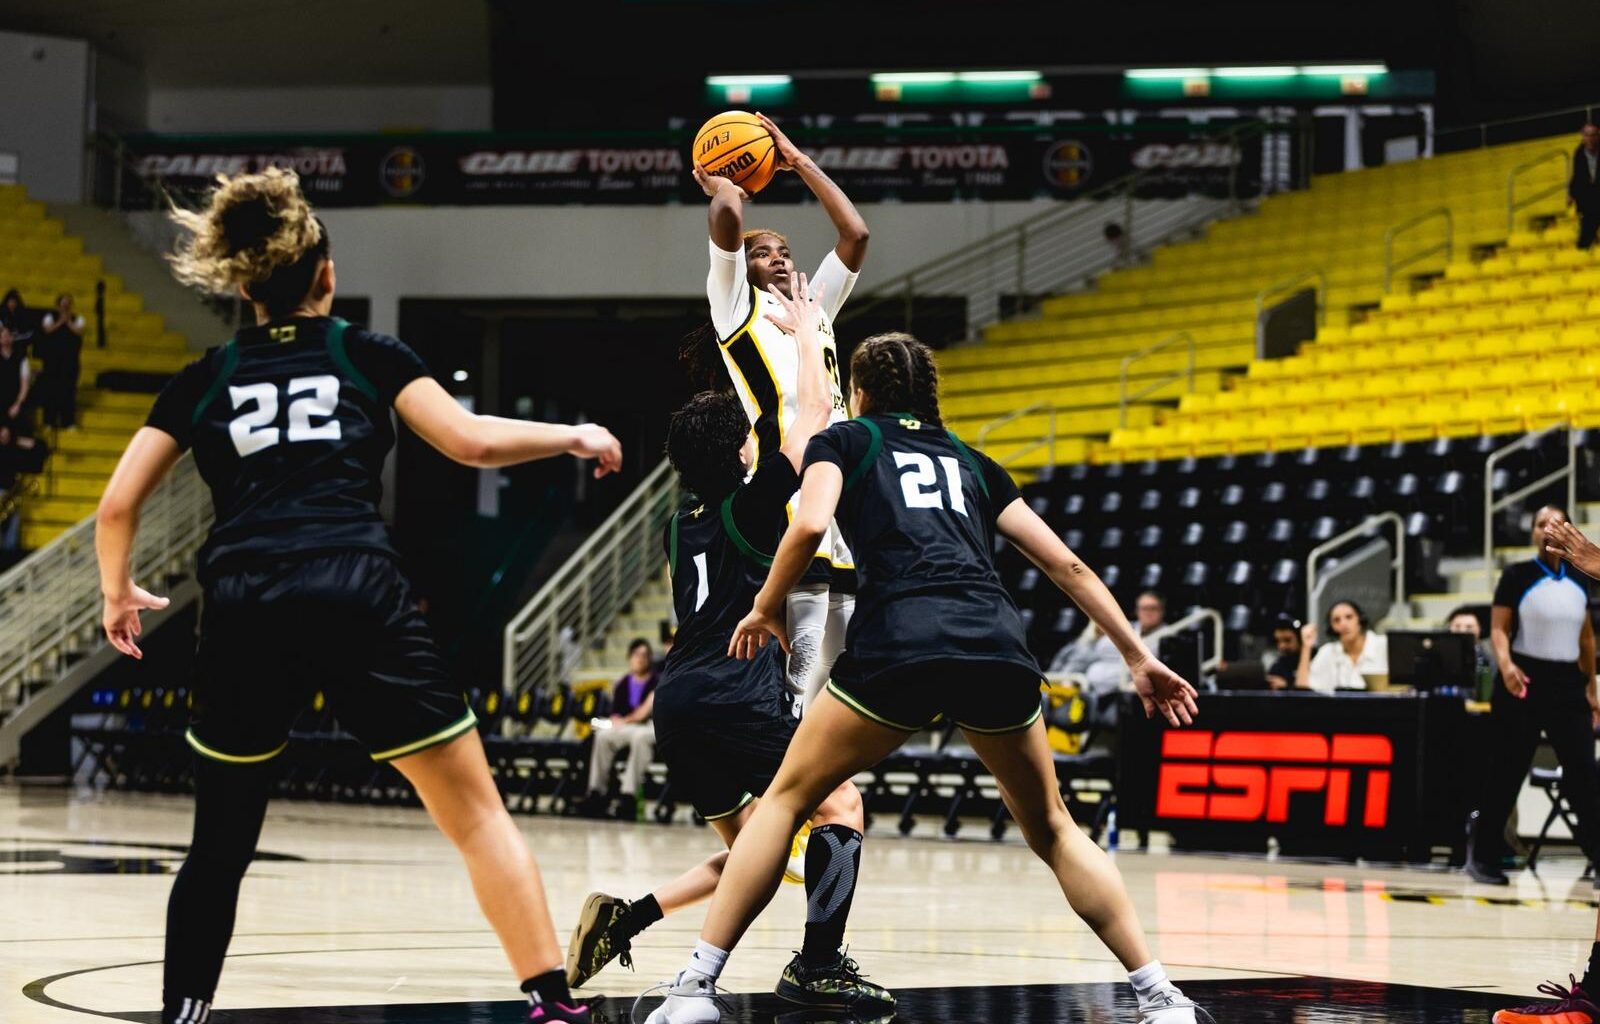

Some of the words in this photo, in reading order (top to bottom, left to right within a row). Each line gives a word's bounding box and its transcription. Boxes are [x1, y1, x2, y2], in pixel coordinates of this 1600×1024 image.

[588, 149, 683, 171] TOYOTA
[908, 145, 1009, 169] TOYOTA
[228, 375, 341, 457] 22
[893, 451, 968, 517] 21
[693, 552, 709, 612] 1
[1156, 730, 1393, 827] ESPN
